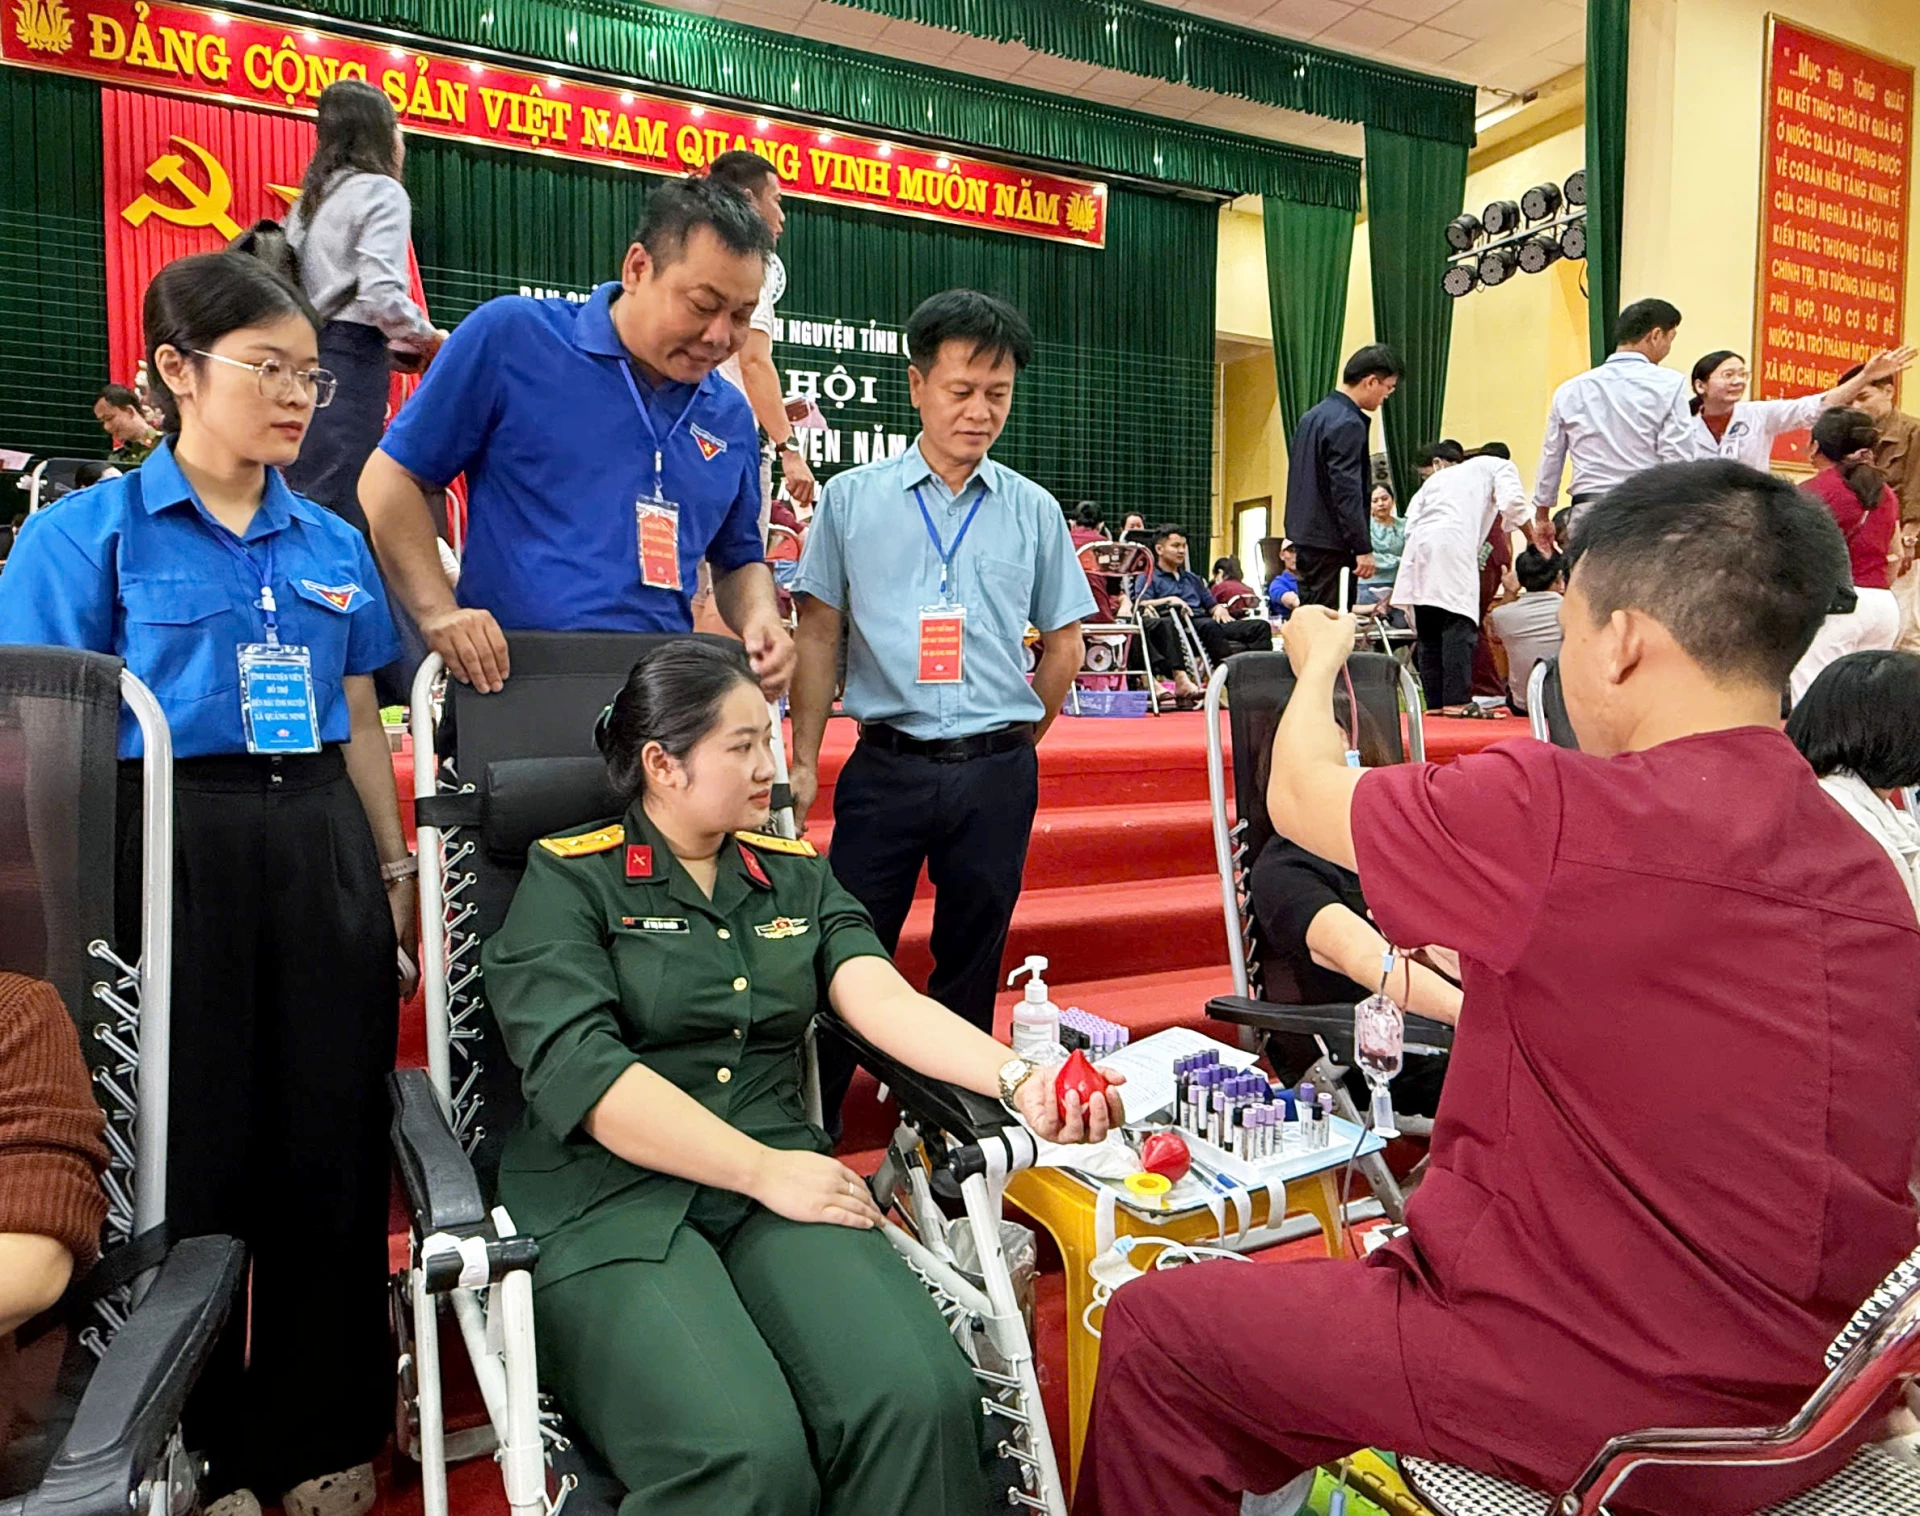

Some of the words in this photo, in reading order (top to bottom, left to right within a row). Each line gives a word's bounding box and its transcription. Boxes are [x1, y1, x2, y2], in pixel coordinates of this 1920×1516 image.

[89, 1, 231, 80] ĐẢNG
[381, 57, 467, 123] SẢN
[478, 84, 571, 145] VIỆT
[581, 105, 668, 158] NAM
[809, 147, 890, 197] VINH
[897, 162, 988, 213] MUÔN
[995, 178, 1060, 226] NĂM
[1777, 86, 1794, 109] KHI
[1795, 87, 1811, 115] KẾT
[1812, 95, 1836, 123] THÚC
[1837, 104, 1858, 130] THỜI
[1786, 122, 1812, 149] NƯỚC
[1836, 137, 1852, 161] XÂY
[1776, 147, 1788, 177] VỀ
[1804, 159, 1823, 187] BẢN
[1825, 162, 1842, 193] NỀN
[1844, 171, 1867, 199] TẢNG
[1869, 184, 1890, 205] KINH
[1891, 185, 1901, 208] TẾ
[1774, 185, 1794, 213] CỦA
[1796, 193, 1817, 218] CHỦ
[1819, 202, 1848, 227] NGHĨA
[1865, 211, 1882, 240] HỘI
[1884, 216, 1899, 241] VỚI
[1773, 219, 1795, 247] KIẾN
[1796, 228, 1821, 254] TRÚC
[1823, 236, 1860, 265] THƯỢNG
[1772, 256, 1800, 283] CHÍNH
[1770, 291, 1789, 315] PHÙ
[1823, 303, 1841, 328] TẠO
[1846, 309, 1860, 329] CƠ
[1866, 306, 1878, 332] SỞ
[789, 319, 855, 354] NGUYỆN
[859, 319, 898, 354] TỈNH
[1768, 323, 1795, 348] NƯỚC
[1796, 331, 1805, 351] TA
[1807, 328, 1823, 355] TRỞ
[1824, 333, 1851, 359] THÀNH
[785, 364, 878, 409] HỘI
[1764, 356, 1778, 381] XÃ
[1780, 359, 1796, 388] HỘI
[1797, 361, 1816, 388] CHỦ
[1817, 368, 1841, 389] NGHĨ
[853, 424, 907, 464] NĂM
